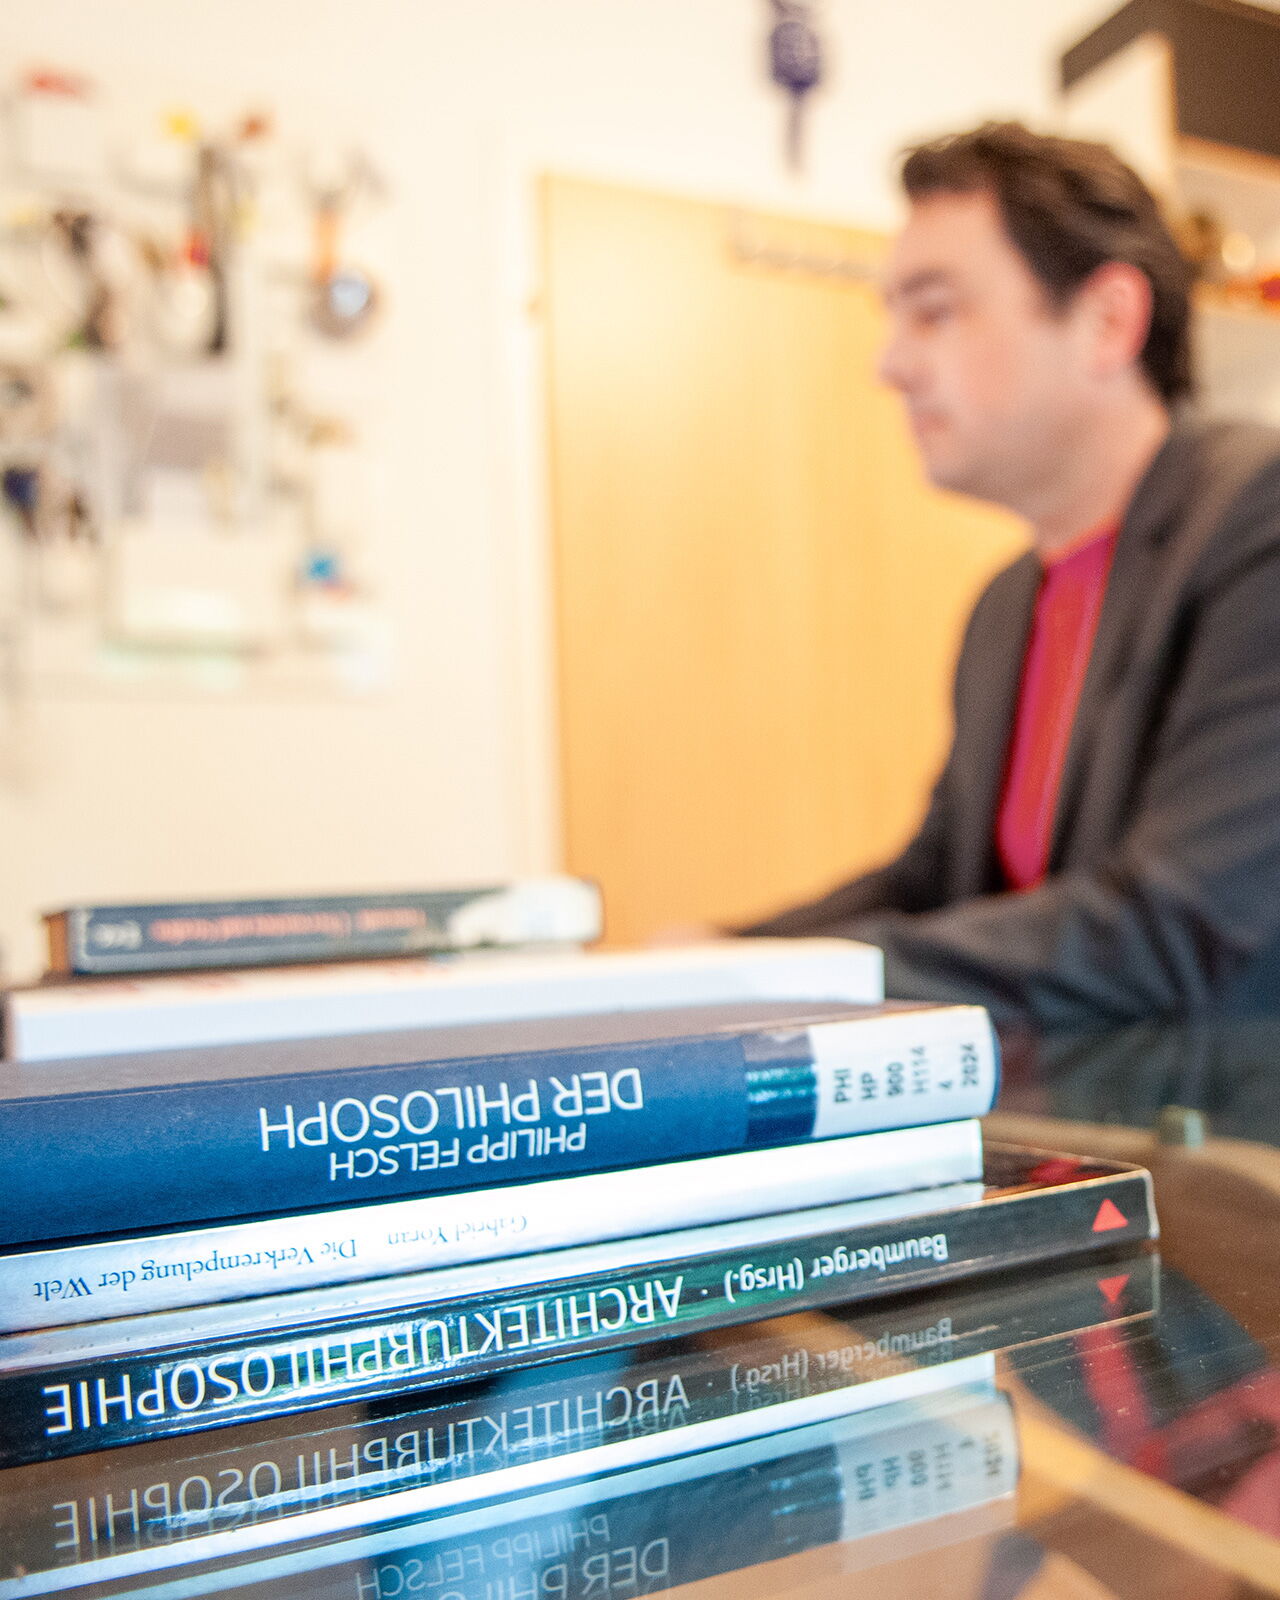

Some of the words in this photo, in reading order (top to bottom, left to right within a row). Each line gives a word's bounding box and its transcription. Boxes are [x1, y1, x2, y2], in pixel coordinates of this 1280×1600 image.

[961, 1042, 979, 1088] 2024
[549, 1067, 644, 1118] DER
[833, 1068, 851, 1104] PHI
[860, 1071, 877, 1100] HP
[258, 1078, 541, 1152] PHILOSOPH
[329, 1137, 460, 1181] FELSCH
[466, 1122, 587, 1164] PHILIPP
[388, 1226, 448, 1246] Yoran
[456, 1215, 527, 1242] Gabriel
[141, 1246, 315, 1282] Verkrempelung
[320, 1239, 357, 1260] Die
[809, 1233, 949, 1279] Baumberger
[33, 1276, 93, 1302] Welt
[98, 1269, 136, 1292] der
[724, 1256, 805, 1304] (Hrsg.)
[42, 1275, 684, 1436] ARCHITEKTURPHILOSOPHIE
